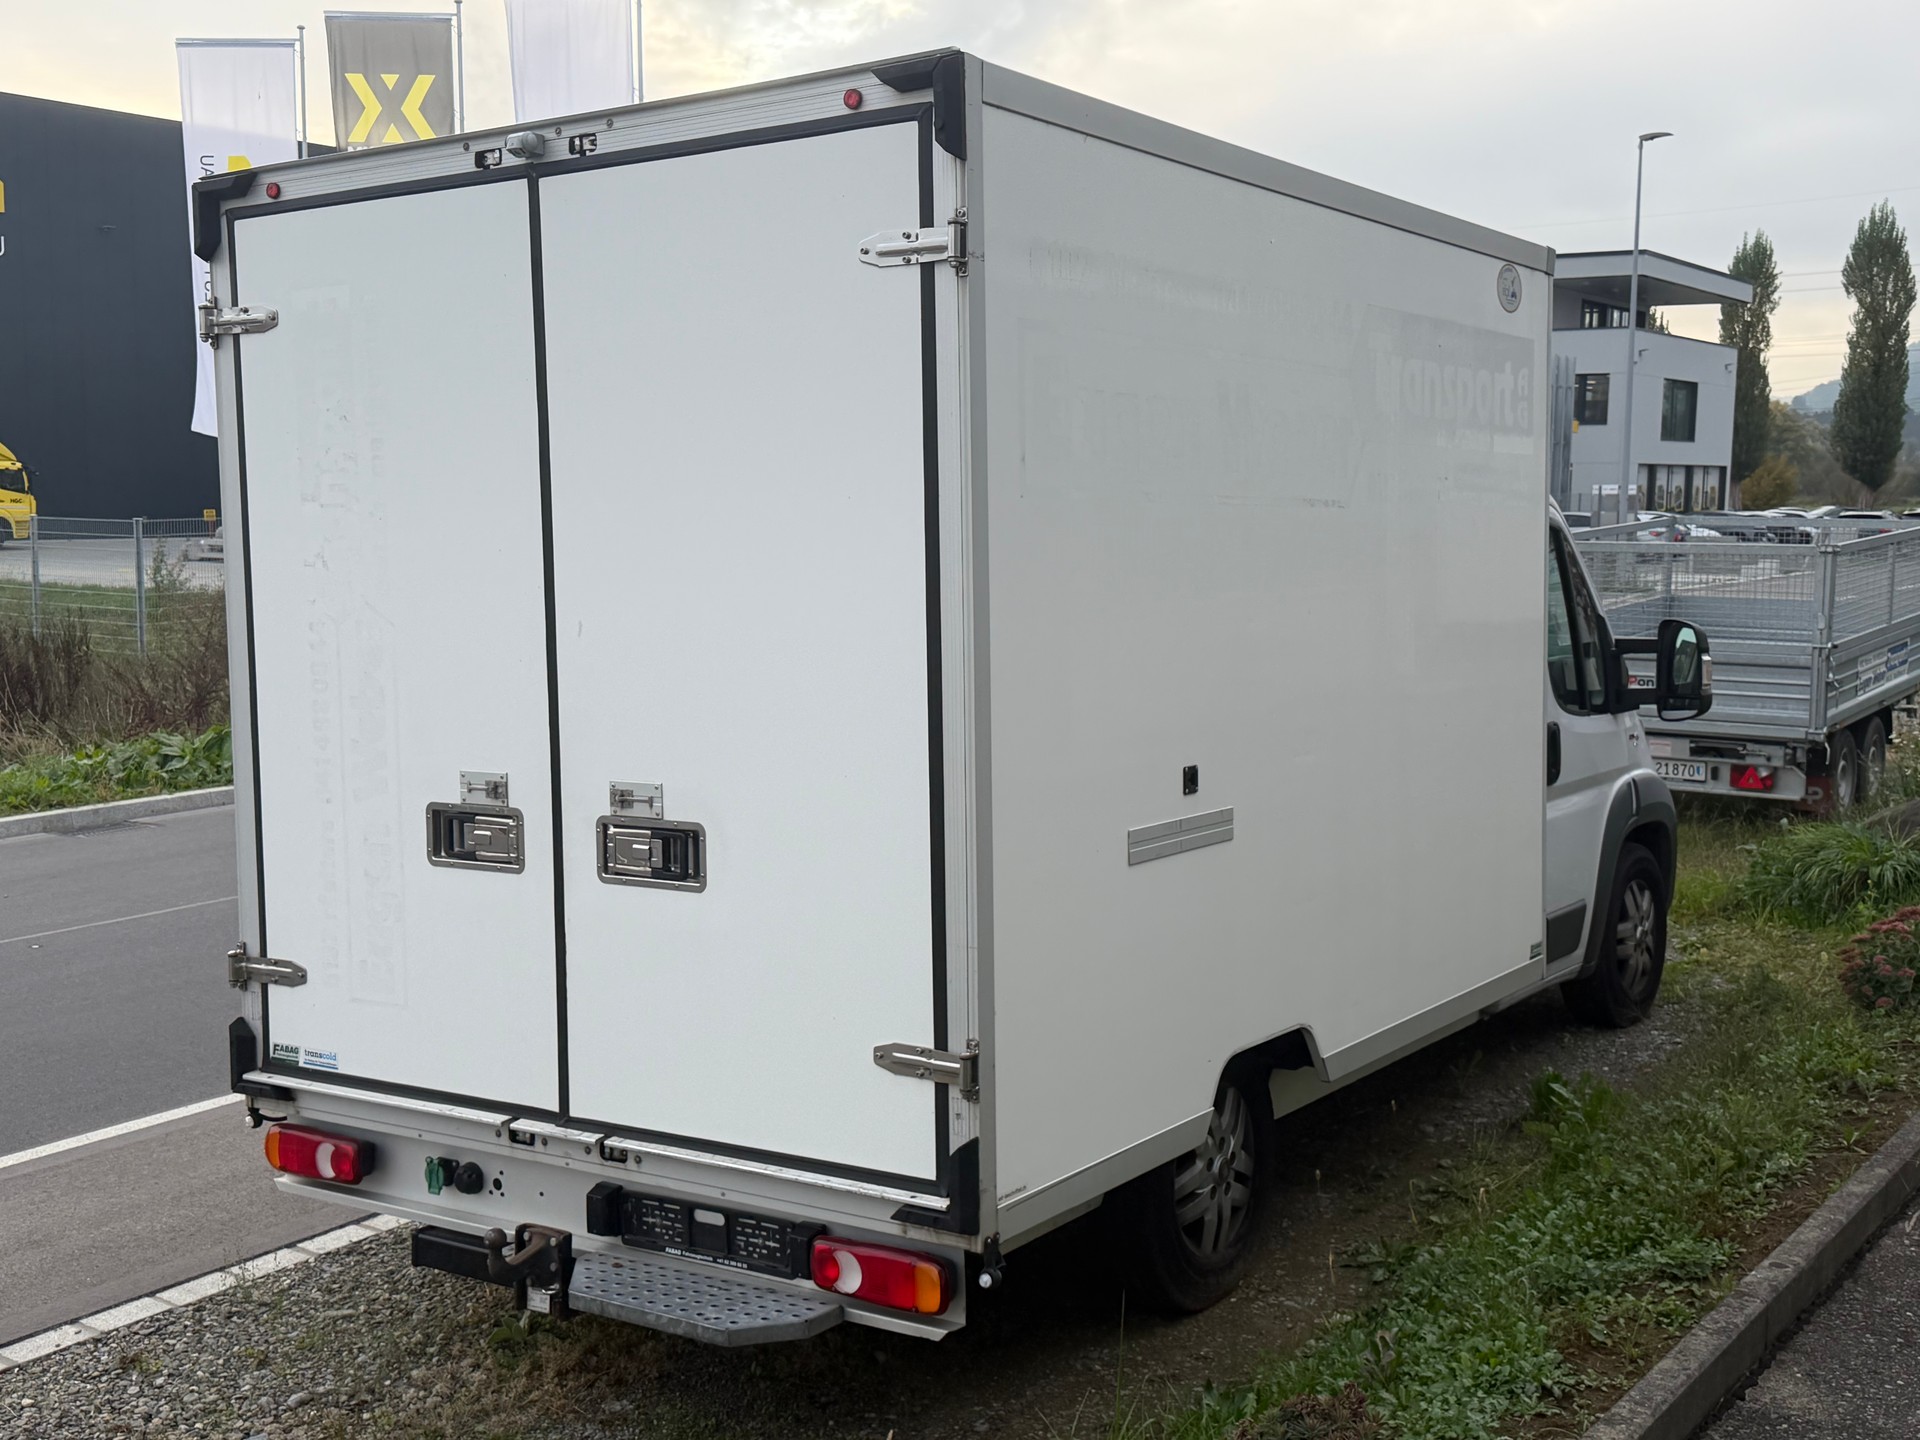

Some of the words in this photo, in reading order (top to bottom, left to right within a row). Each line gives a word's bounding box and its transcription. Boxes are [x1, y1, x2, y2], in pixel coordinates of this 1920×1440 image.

[1655, 762, 1696, 777] 21870
[273, 1044, 299, 1055] FABAG
[304, 1049, 337, 1061] transcold
